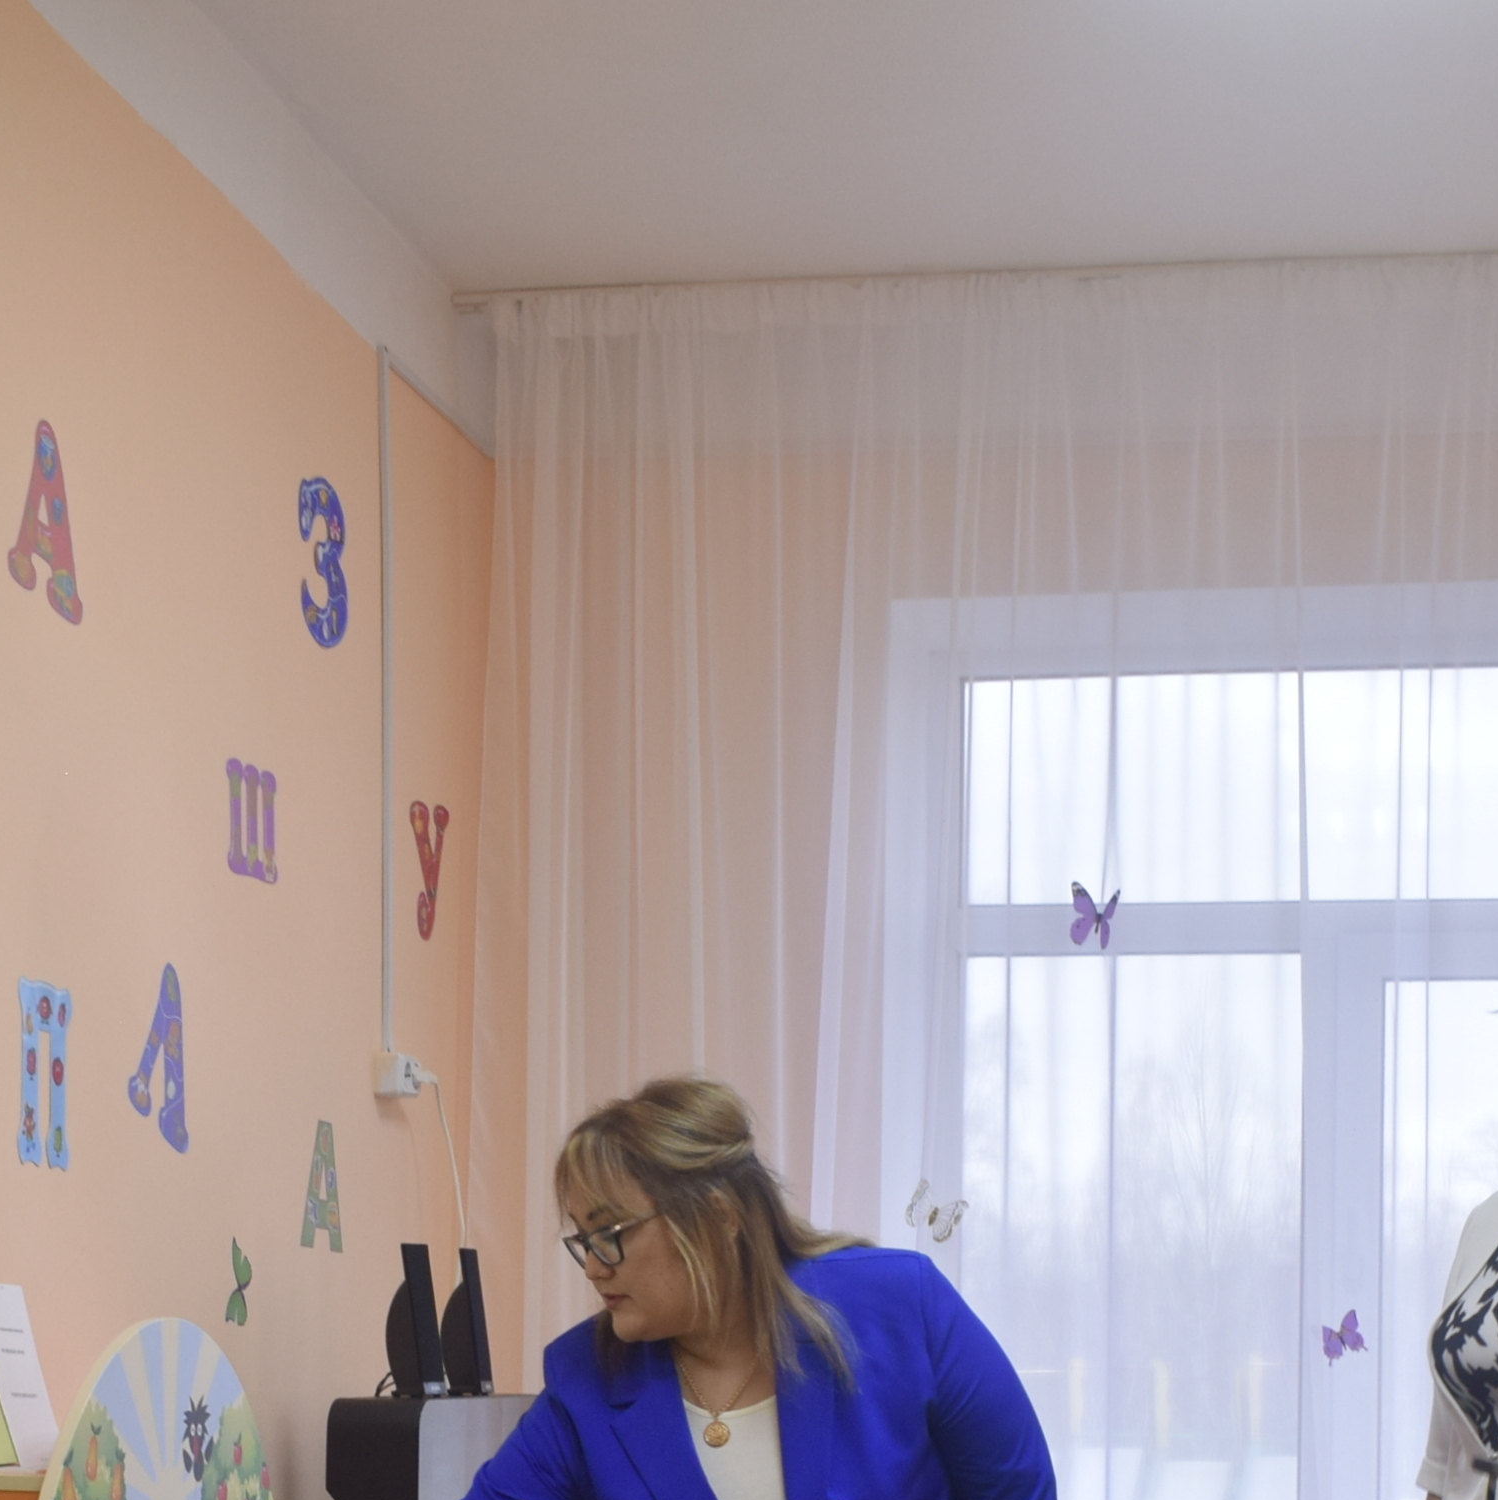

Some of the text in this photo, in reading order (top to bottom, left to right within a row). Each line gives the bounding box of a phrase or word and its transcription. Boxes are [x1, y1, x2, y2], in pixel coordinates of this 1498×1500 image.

[7, 418, 83, 626] А
[226, 757, 278, 884] Ш
[409, 800, 450, 941] У
[17, 975, 73, 1172] П
[127, 962, 189, 1155] Л
[300, 1120, 343, 1253] А
